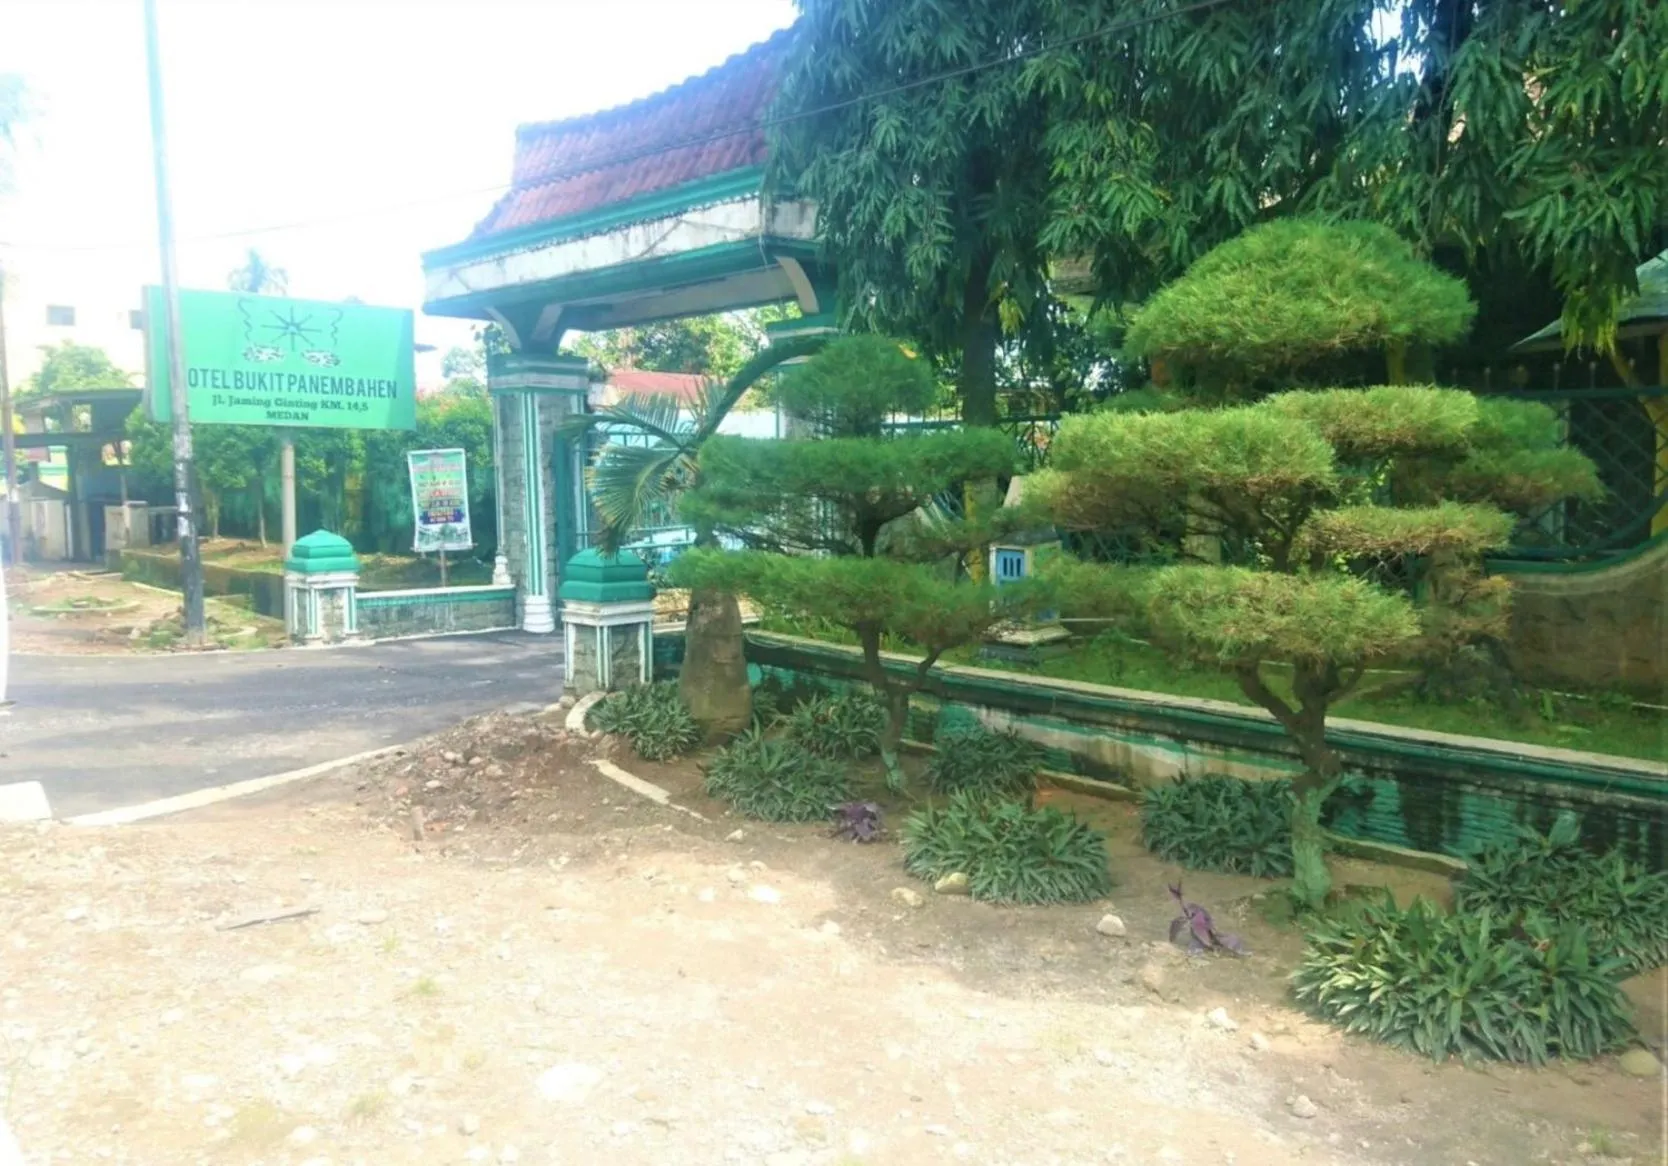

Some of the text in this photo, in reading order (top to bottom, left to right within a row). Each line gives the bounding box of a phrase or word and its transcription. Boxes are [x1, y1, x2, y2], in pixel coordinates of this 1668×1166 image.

[188, 368, 397, 399] OTEL BUKIT PANEMBAHEN
[274, 397, 318, 410] Ginting
[347, 401, 369, 413] 14,5
[266, 410, 309, 421] MEDAN
